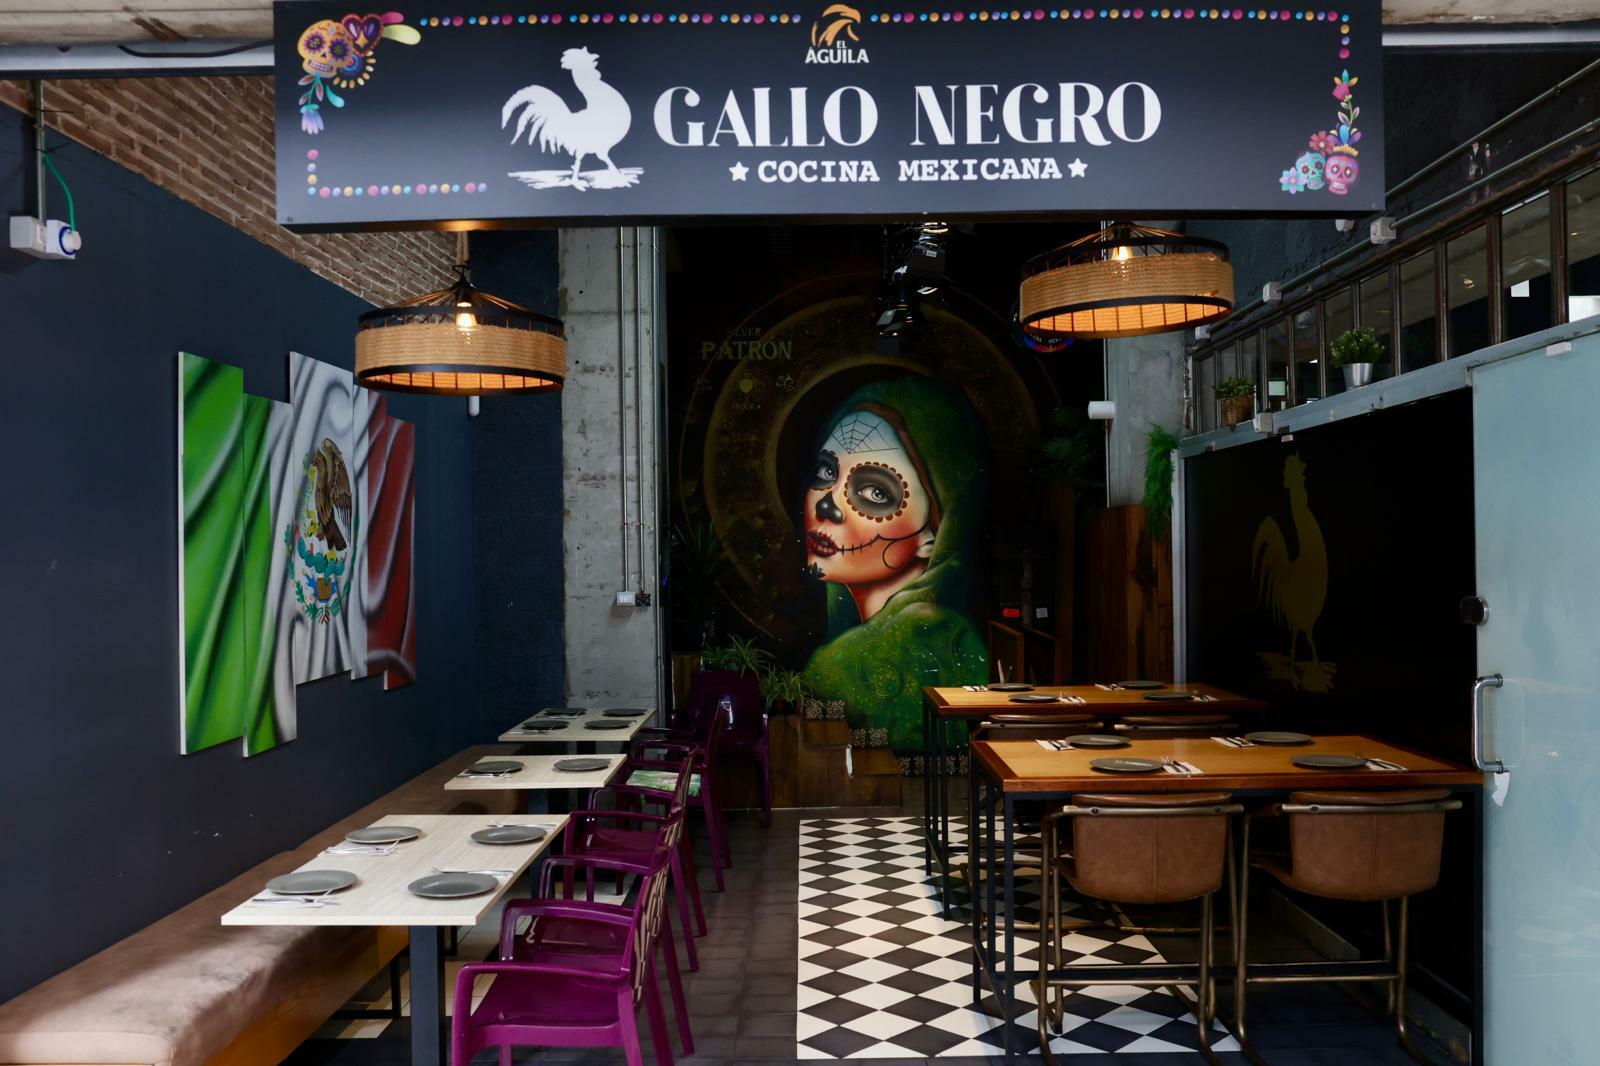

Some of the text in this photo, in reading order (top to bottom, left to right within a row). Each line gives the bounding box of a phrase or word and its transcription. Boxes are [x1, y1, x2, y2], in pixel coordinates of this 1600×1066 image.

[836, 40, 847, 49] EL
[653, 81, 1163, 148] GALLO NEGRO
[757, 157, 1063, 184] COCINA MEXICANA
